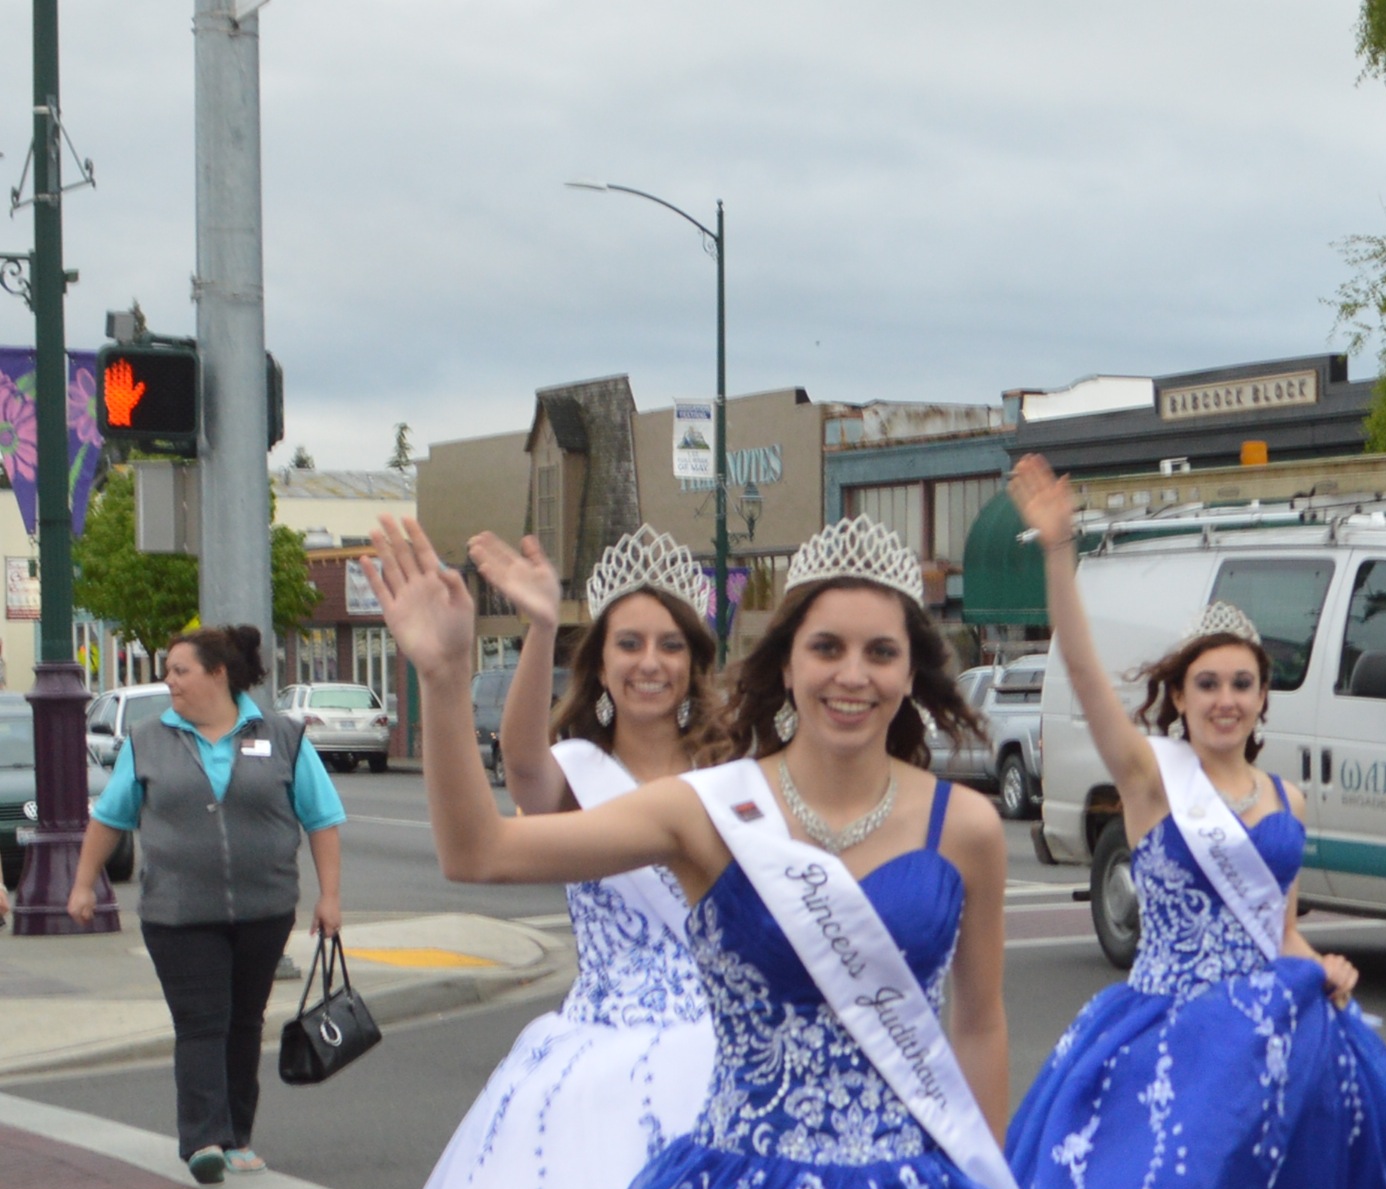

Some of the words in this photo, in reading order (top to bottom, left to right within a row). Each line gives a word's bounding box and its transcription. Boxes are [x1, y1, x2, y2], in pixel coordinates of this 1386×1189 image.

[1169, 386, 1244, 414] BABCOCK
[1252, 378, 1307, 403] BLOCK
[784, 863, 867, 979] Princess
